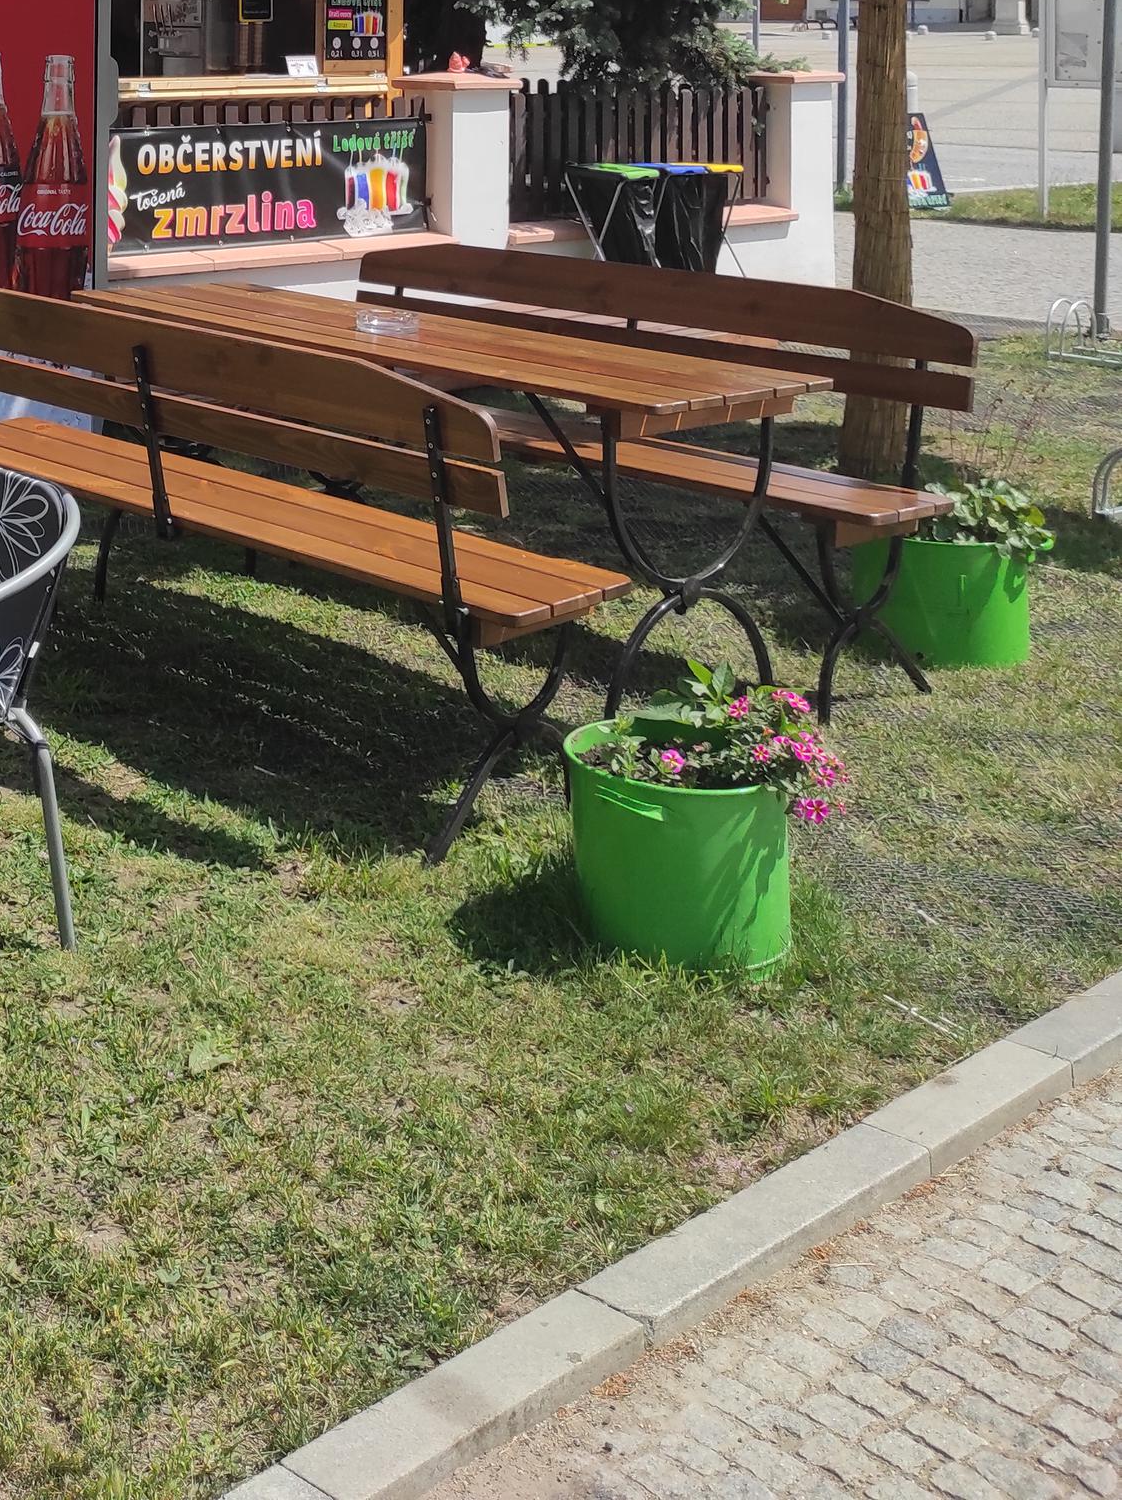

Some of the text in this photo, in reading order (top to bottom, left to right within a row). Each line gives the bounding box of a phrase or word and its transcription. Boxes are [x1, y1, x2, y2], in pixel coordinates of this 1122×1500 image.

[137, 130, 323, 175] OBČERSTVENÍ
[17, 203, 89, 236] Coca-Cola
[151, 191, 318, 240] zmrzlina
